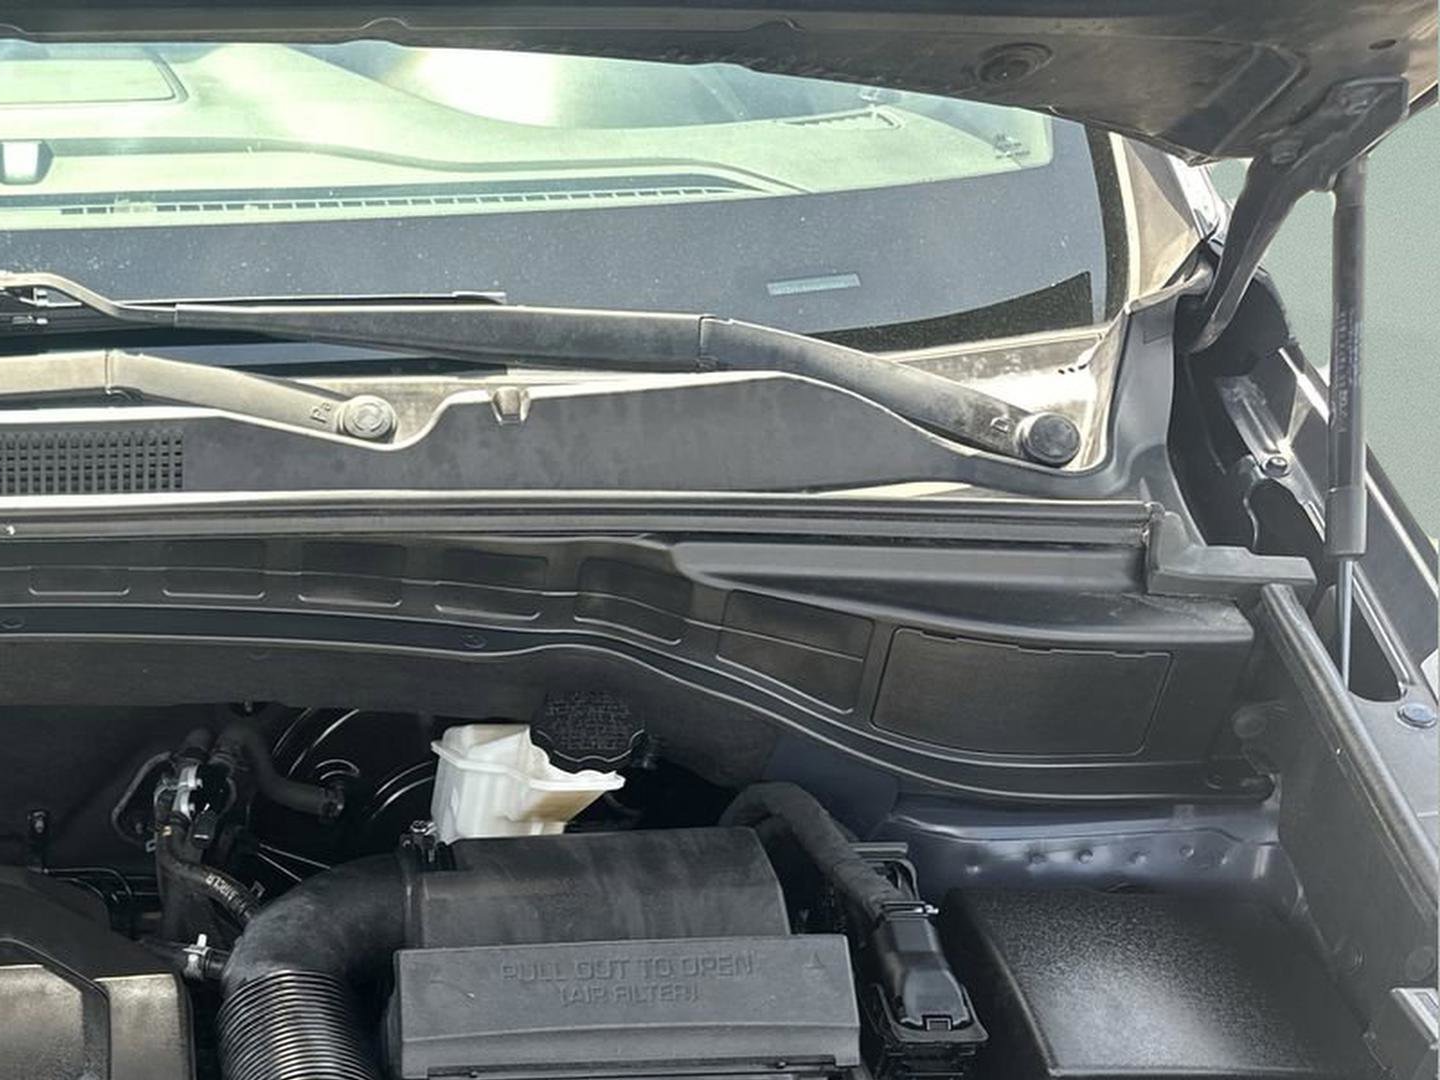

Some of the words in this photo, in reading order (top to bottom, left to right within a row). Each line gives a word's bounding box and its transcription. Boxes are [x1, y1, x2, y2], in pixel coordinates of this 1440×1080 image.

[501, 959, 569, 983] PULL
[575, 958, 631, 981] OUT
[639, 957, 674, 980] TO
[680, 951, 755, 978] OPEN
